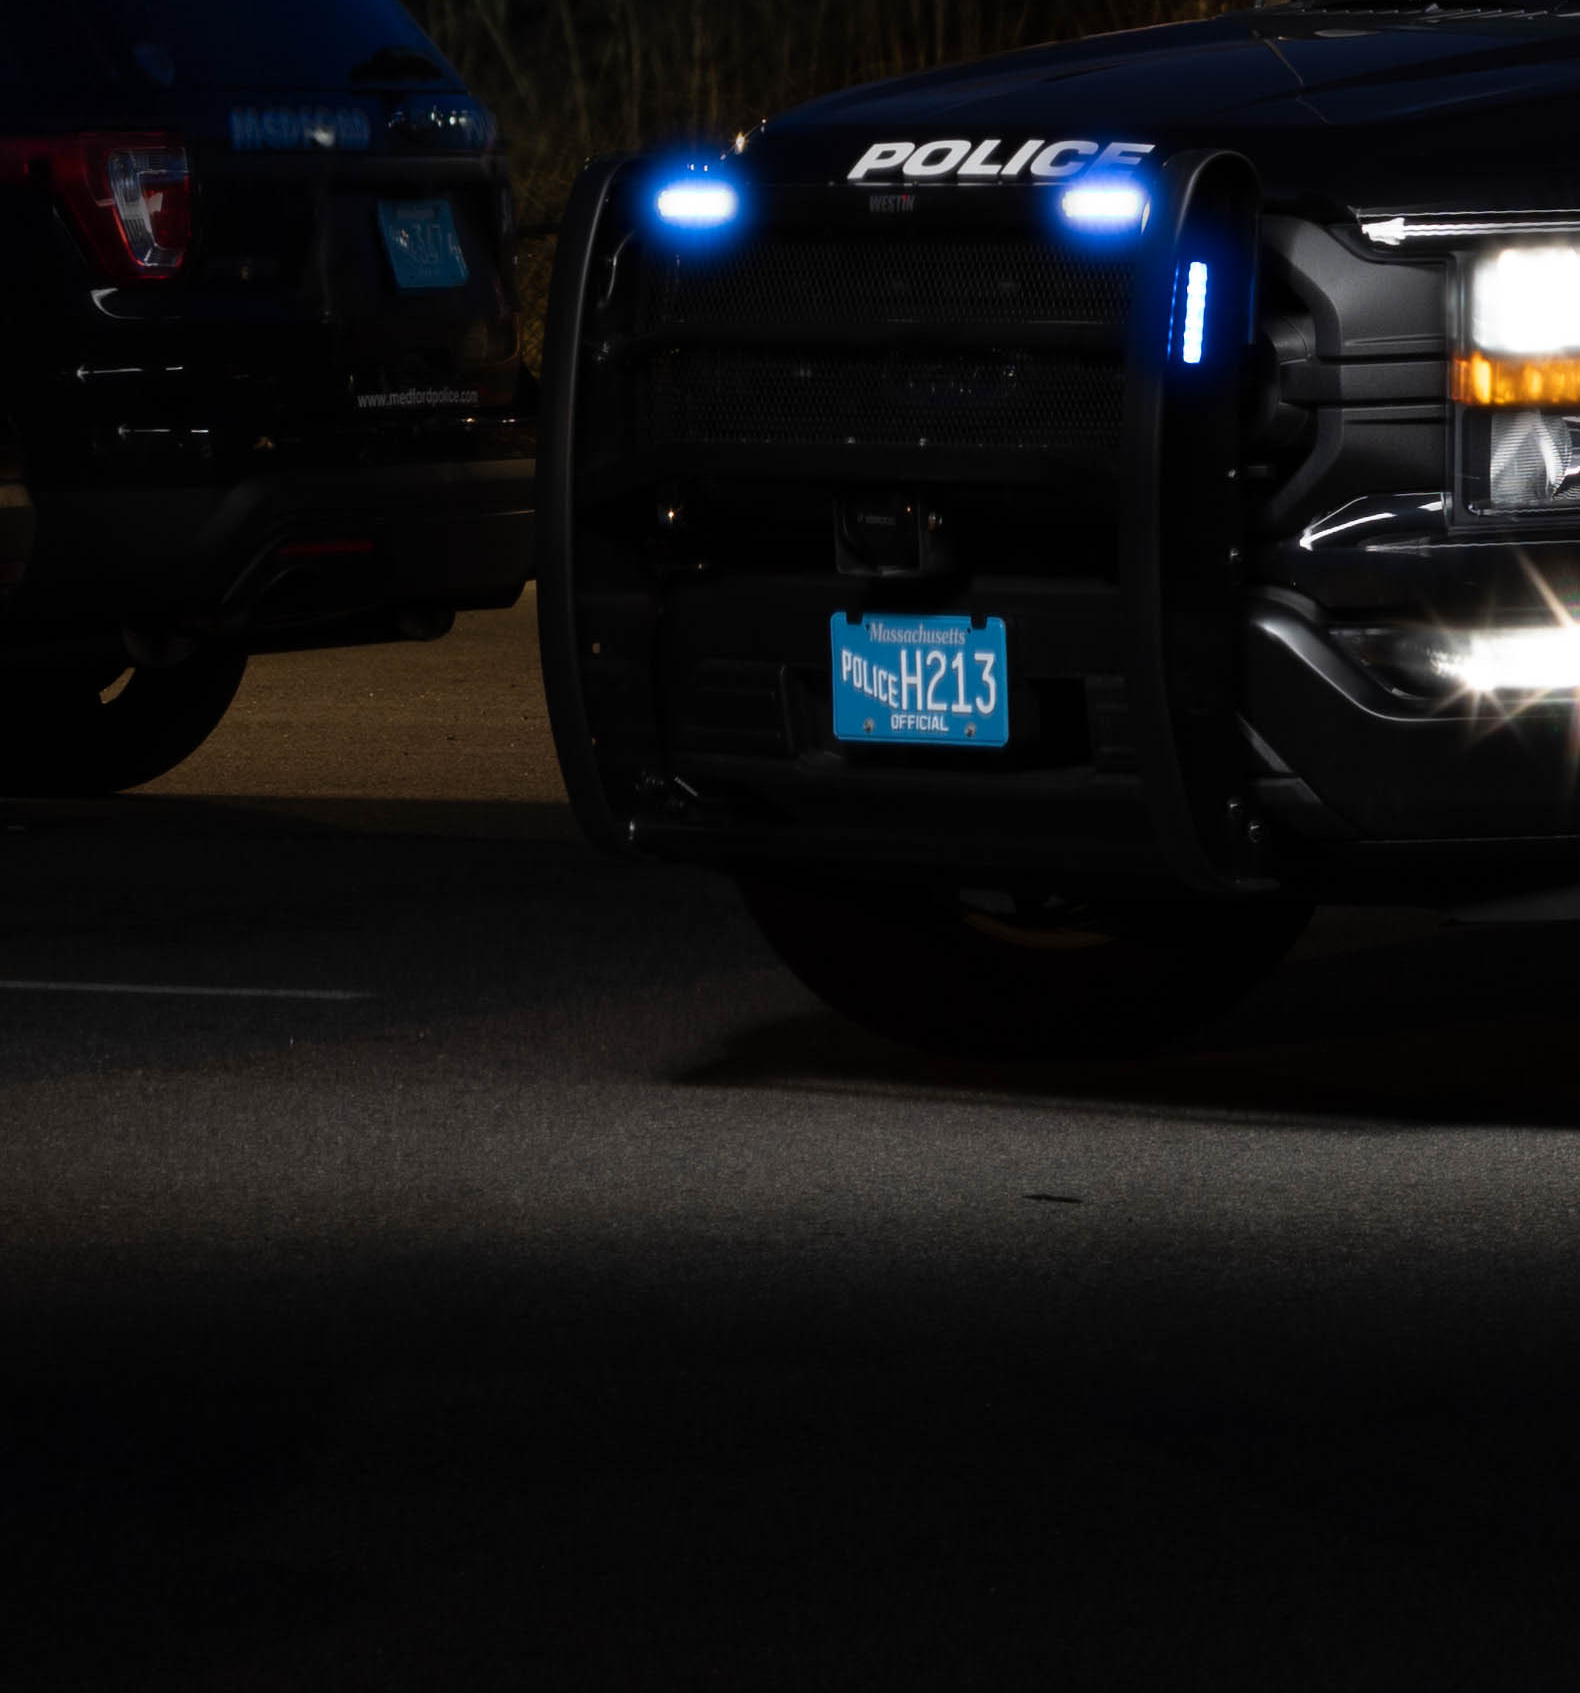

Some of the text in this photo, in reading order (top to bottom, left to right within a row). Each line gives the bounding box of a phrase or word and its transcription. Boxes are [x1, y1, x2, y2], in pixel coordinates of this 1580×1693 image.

[847, 138, 1156, 181] POLICE
[869, 622, 966, 645] Massachusetts
[841, 649, 997, 715] POLICE H213
[890, 713, 950, 732] OFFICIAL
